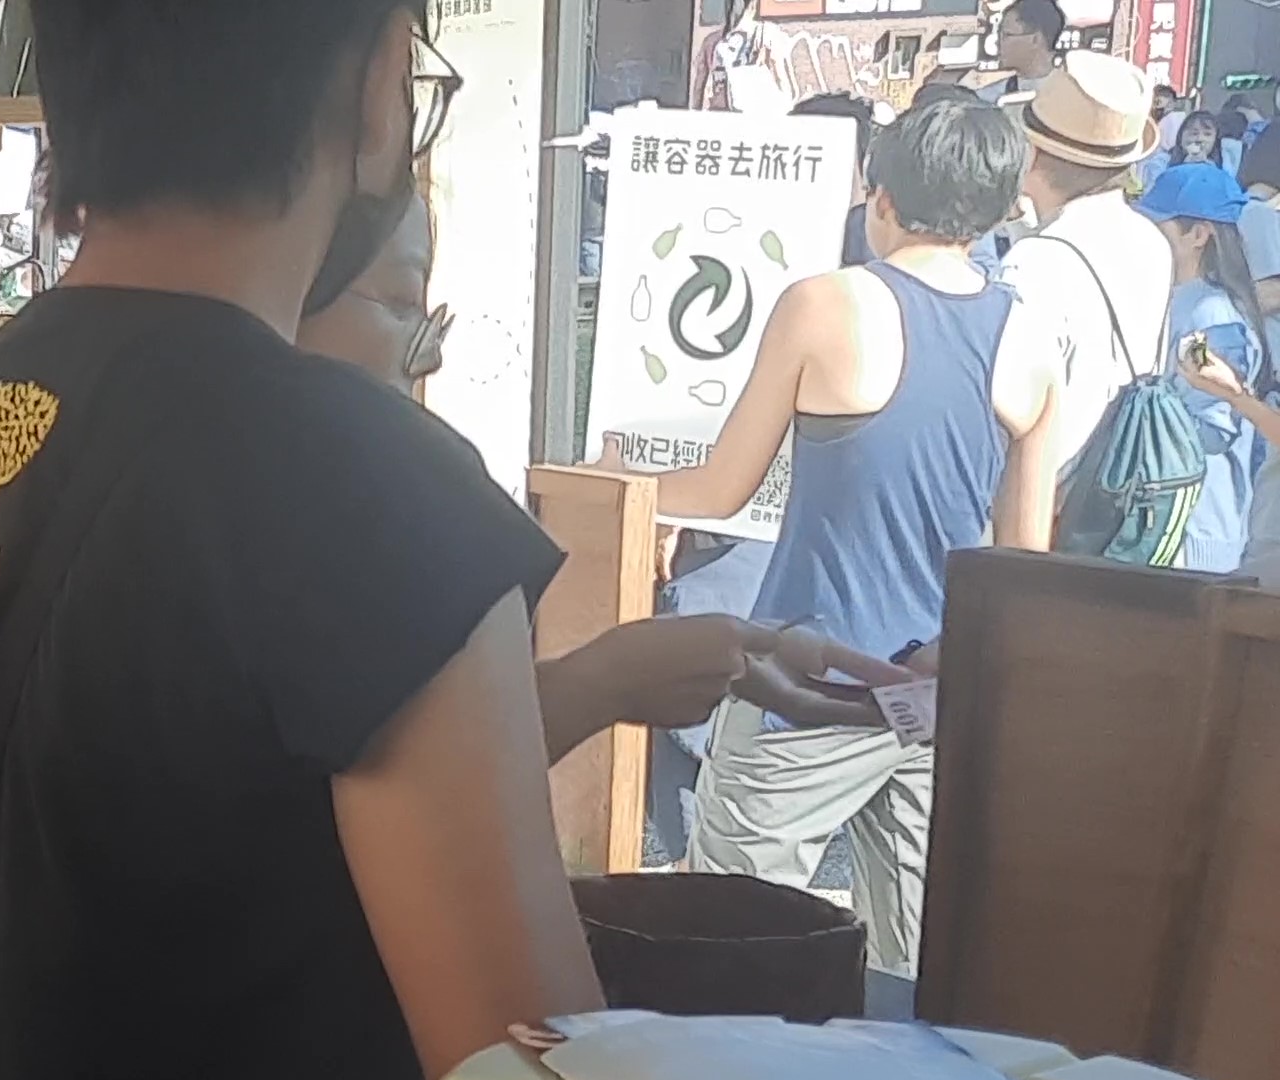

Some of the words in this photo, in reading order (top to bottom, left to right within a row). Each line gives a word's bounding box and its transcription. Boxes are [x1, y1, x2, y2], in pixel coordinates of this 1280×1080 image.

[630, 135, 823, 182] 讓容器去旅行
